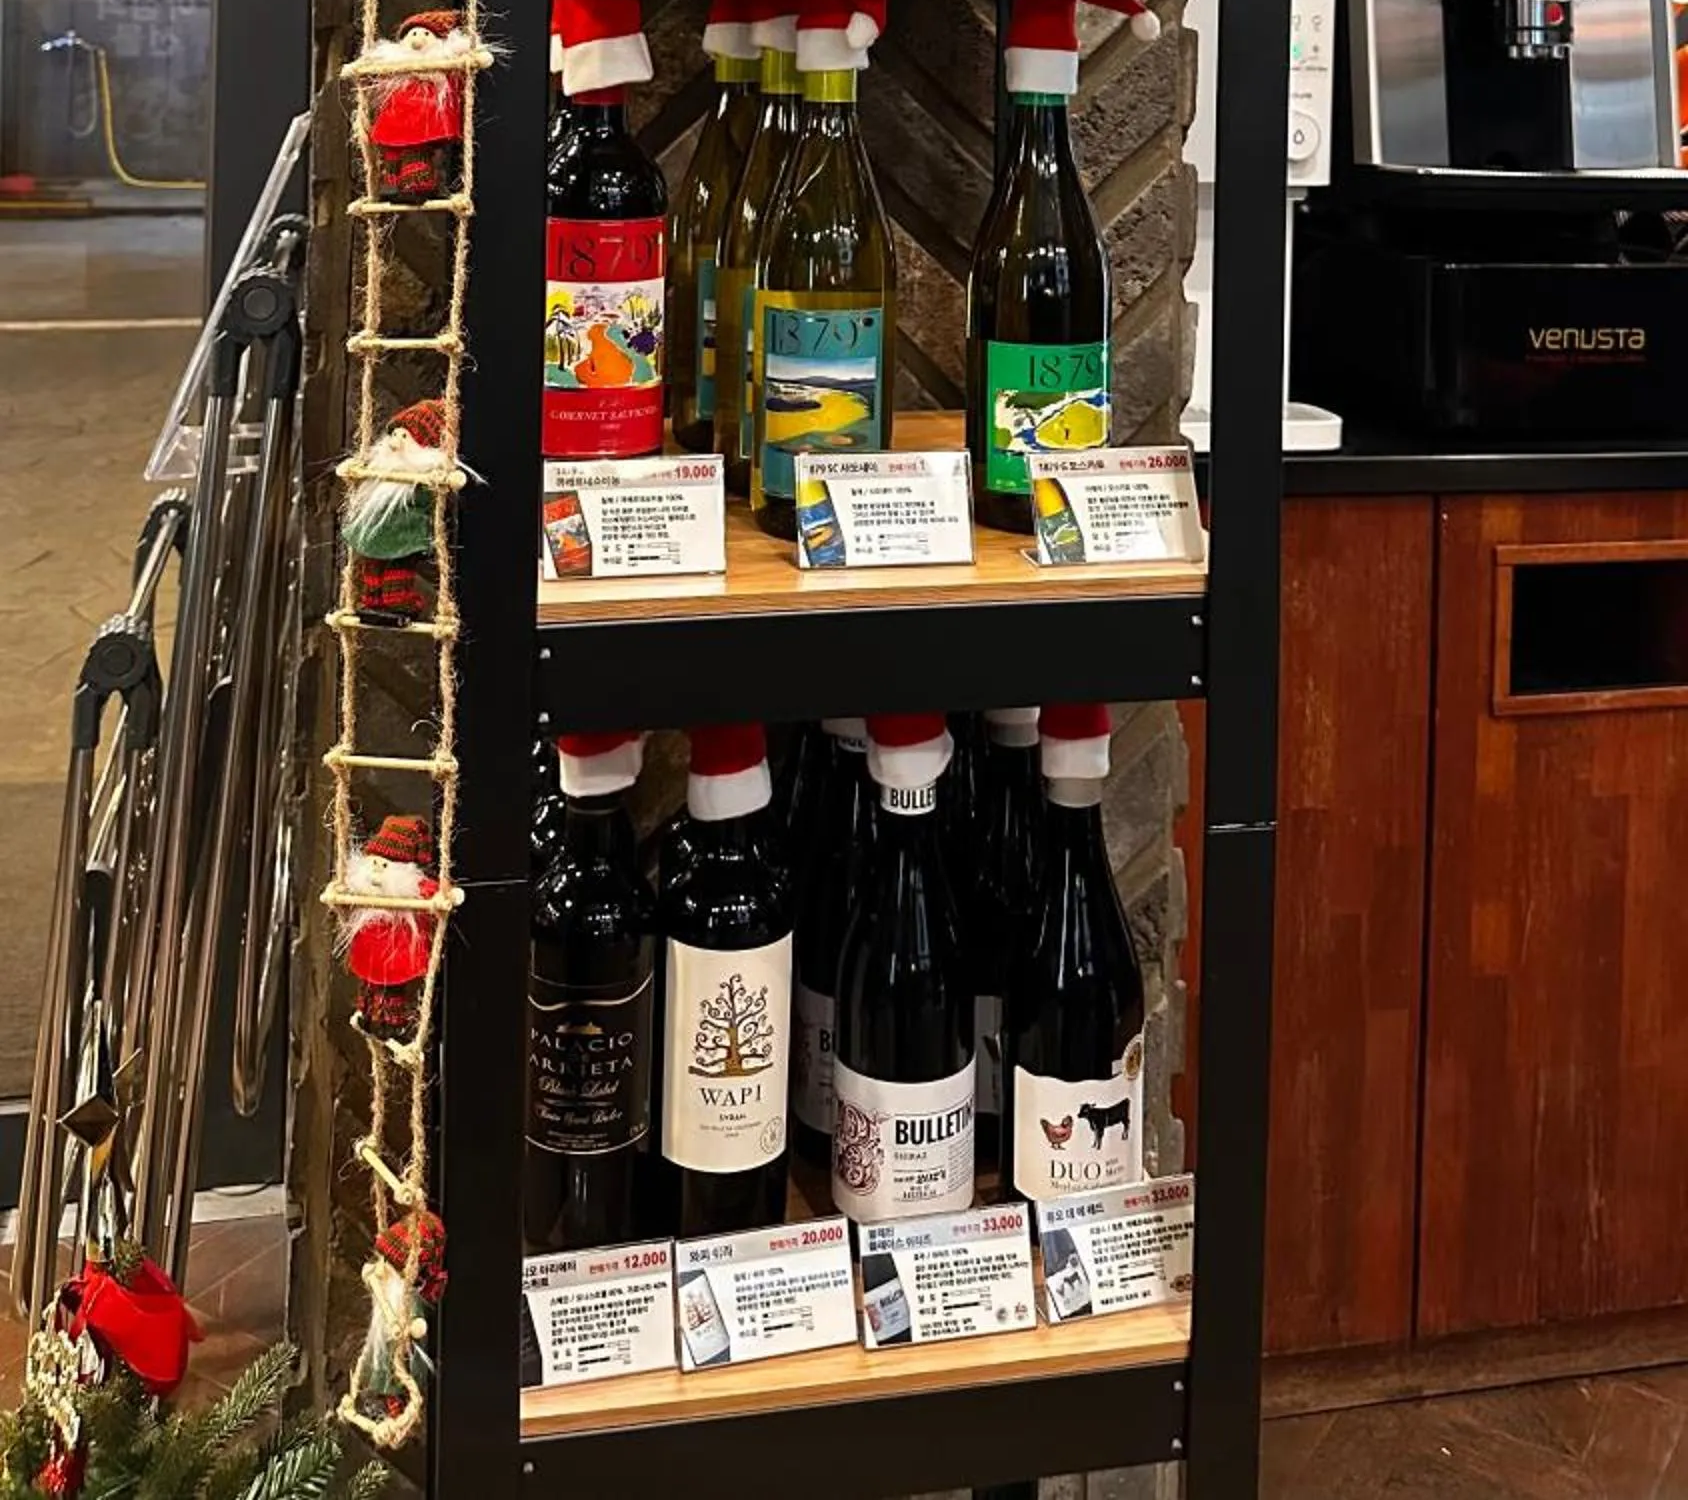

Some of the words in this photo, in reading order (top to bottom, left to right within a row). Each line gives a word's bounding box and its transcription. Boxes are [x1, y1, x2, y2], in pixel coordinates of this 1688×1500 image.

[1029, 352, 1101, 388] 1879
[698, 1084, 763, 1107] WAPI
[1051, 1159, 1101, 1182] DUO
